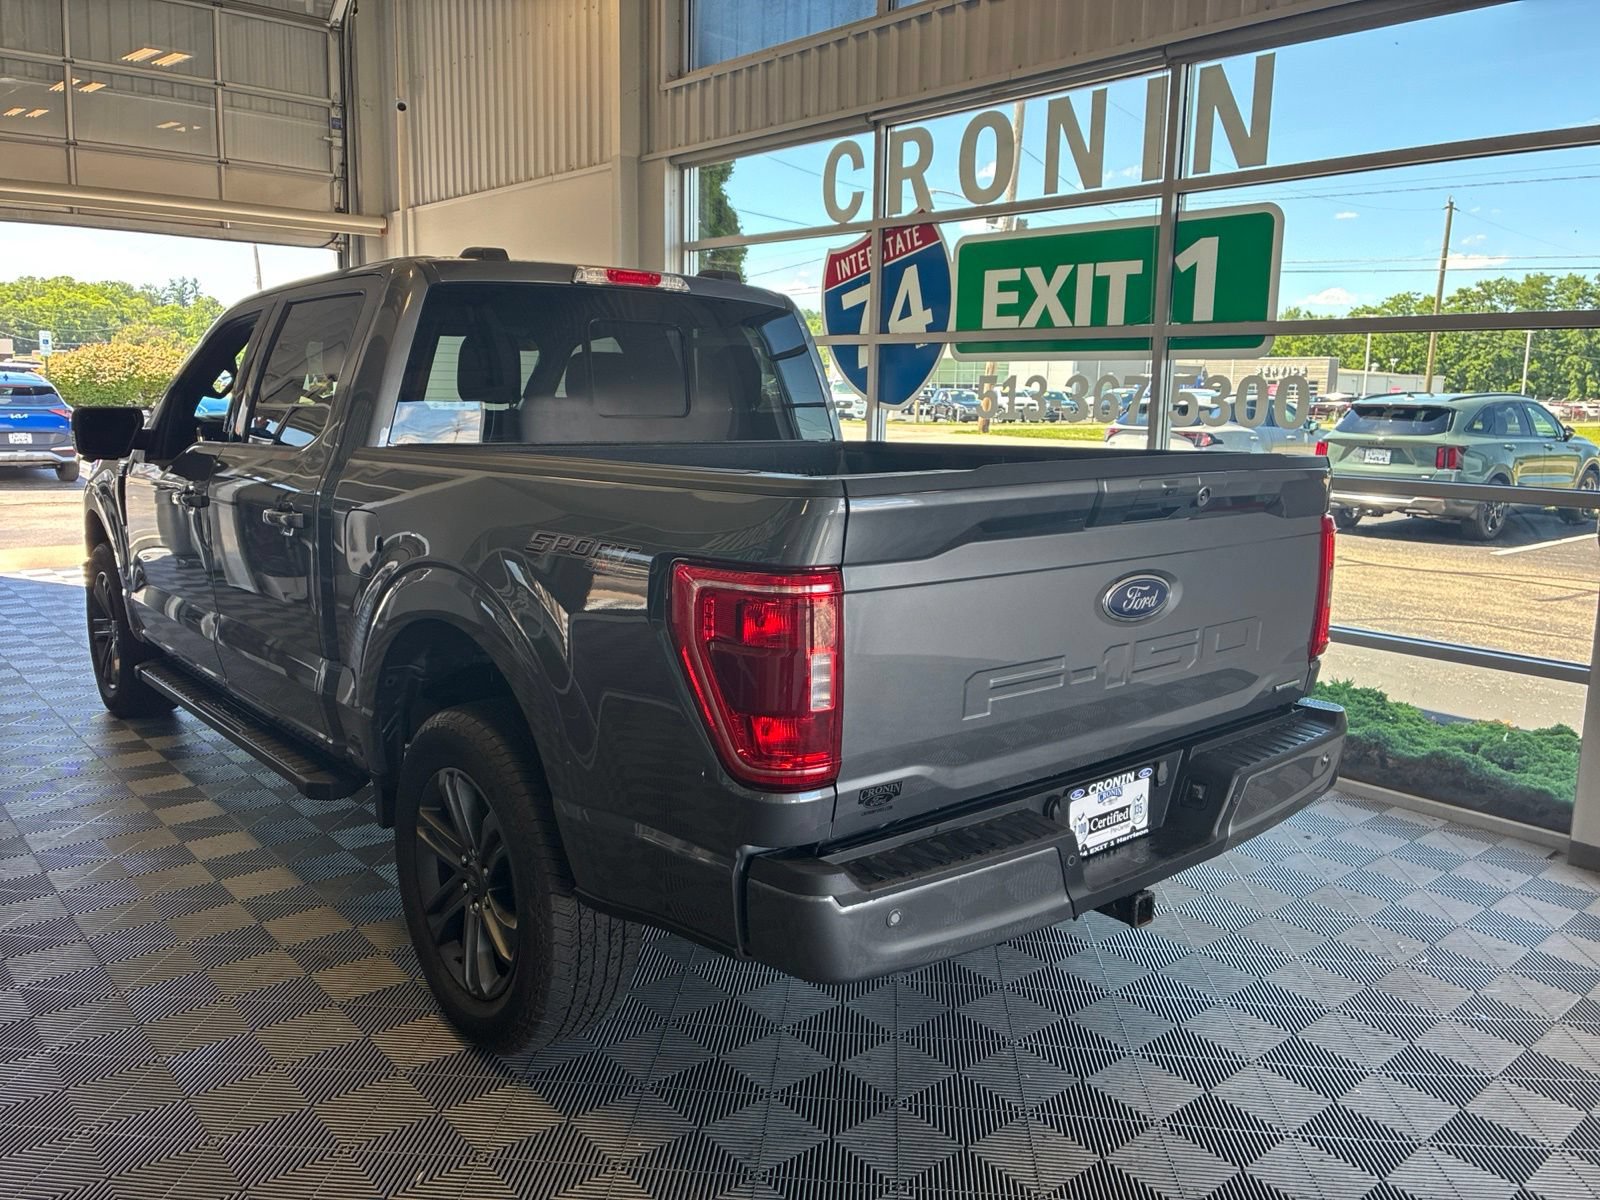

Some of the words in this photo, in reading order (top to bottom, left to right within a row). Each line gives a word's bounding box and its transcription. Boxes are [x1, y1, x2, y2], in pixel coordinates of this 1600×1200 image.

[823, 52, 1276, 224] CRONIN
[836, 225, 923, 281] INTERTATE
[981, 259, 1143, 330] EXIT
[1174, 236, 1220, 322] 1
[841, 263, 934, 369] 74
[1255, 364, 1309, 378] SERVICE
[1122, 585, 1159, 612] Ford
[962, 615, 1264, 722] F-150
[859, 781, 902, 801] CRONIN
[1088, 772, 1134, 795] CRONIN
[1098, 786, 1123, 803] CRONIN
[1090, 808, 1128, 831] Certified
[1090, 842, 1108, 854] EXIT
[1117, 829, 1148, 843] Harrison
